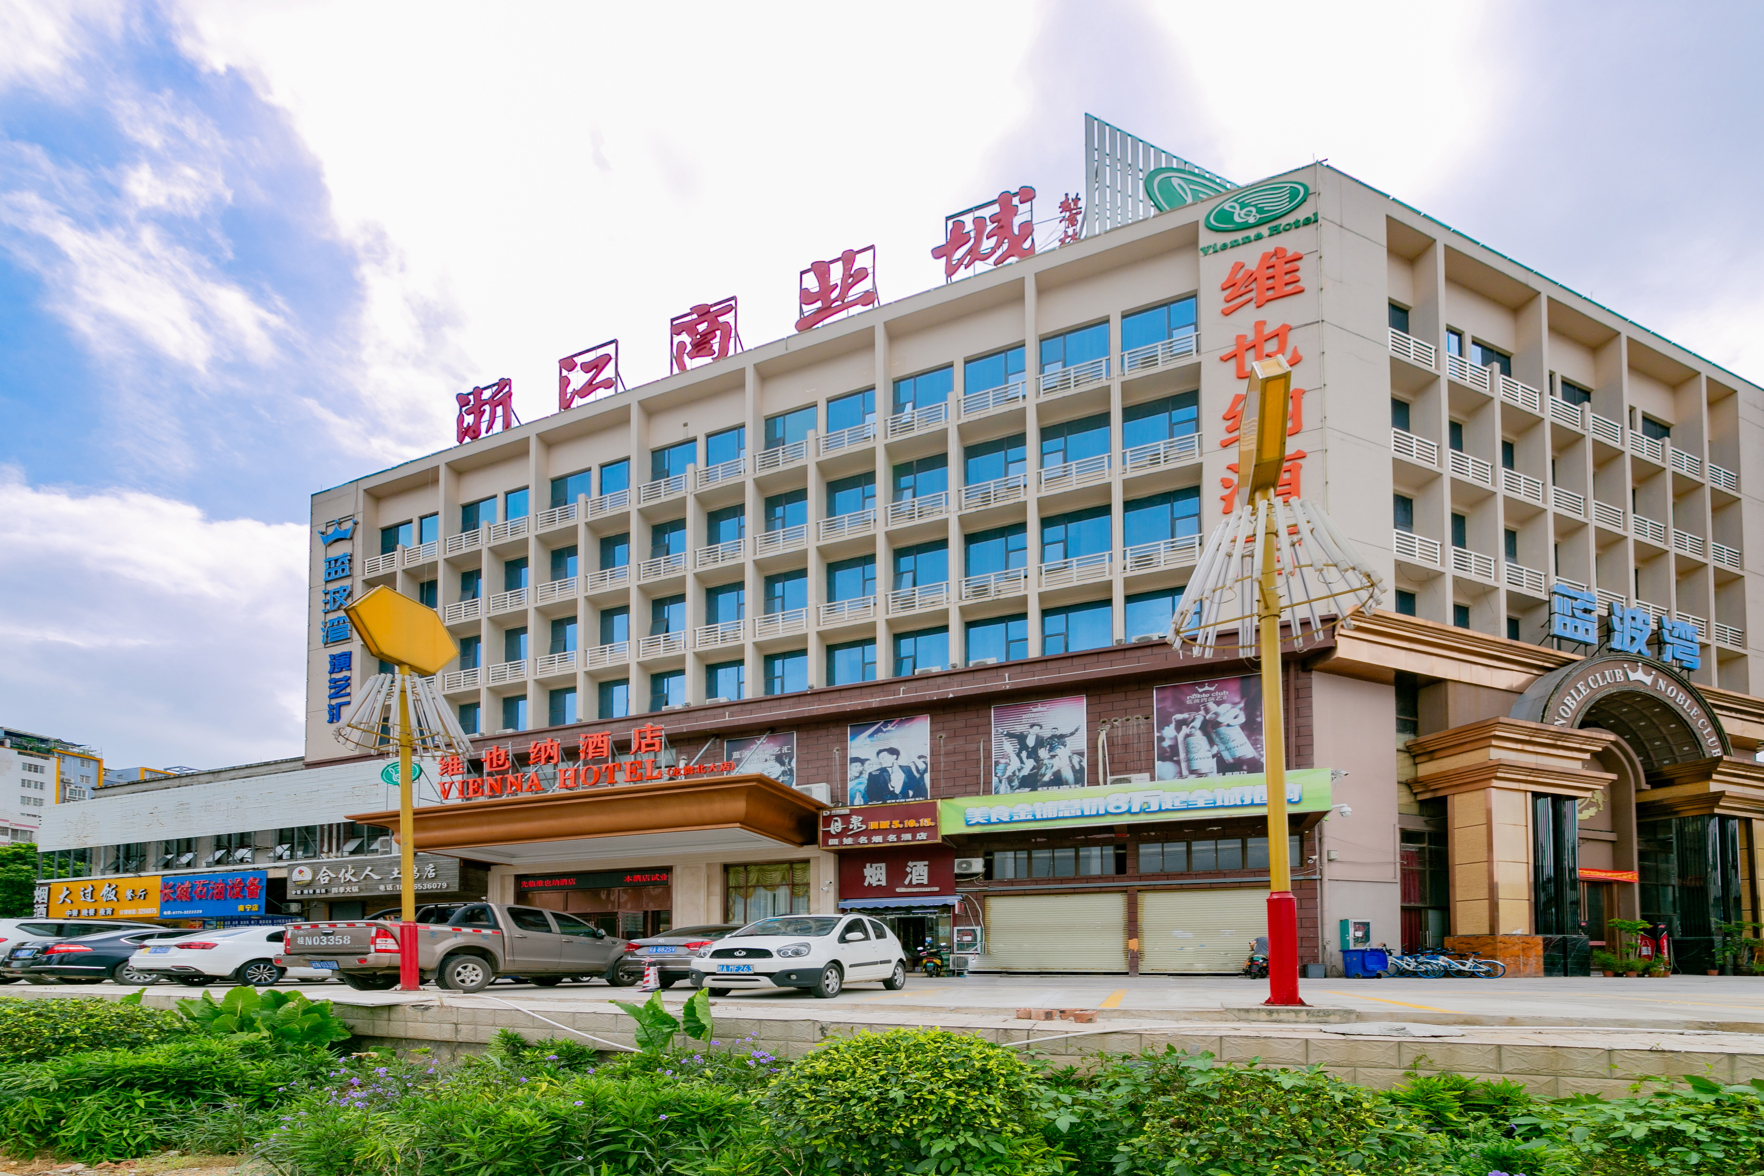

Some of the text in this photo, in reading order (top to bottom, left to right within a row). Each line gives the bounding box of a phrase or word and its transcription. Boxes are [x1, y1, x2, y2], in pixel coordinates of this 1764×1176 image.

[1199, 211, 1319, 257] Vienna Hotel
[456, 186, 1036, 444] 浙江商业城
[321, 552, 352, 645] 蓝波湾
[1550, 583, 1701, 671] 蓝波湾
[327, 650, 352, 724] 演艺汇
[1553, 668, 1722, 758] NOBLE CLUB NOBLE CLUB
[438, 723, 665, 777] 维也纳酒店
[437, 758, 663, 800] VIENNA HOTEL
[160, 876, 262, 903] 长城石油设备
[315, 864, 383, 886] 合伙人
[863, 860, 930, 887] 烟酒
[297, 934, 351, 946] 桂N03358
